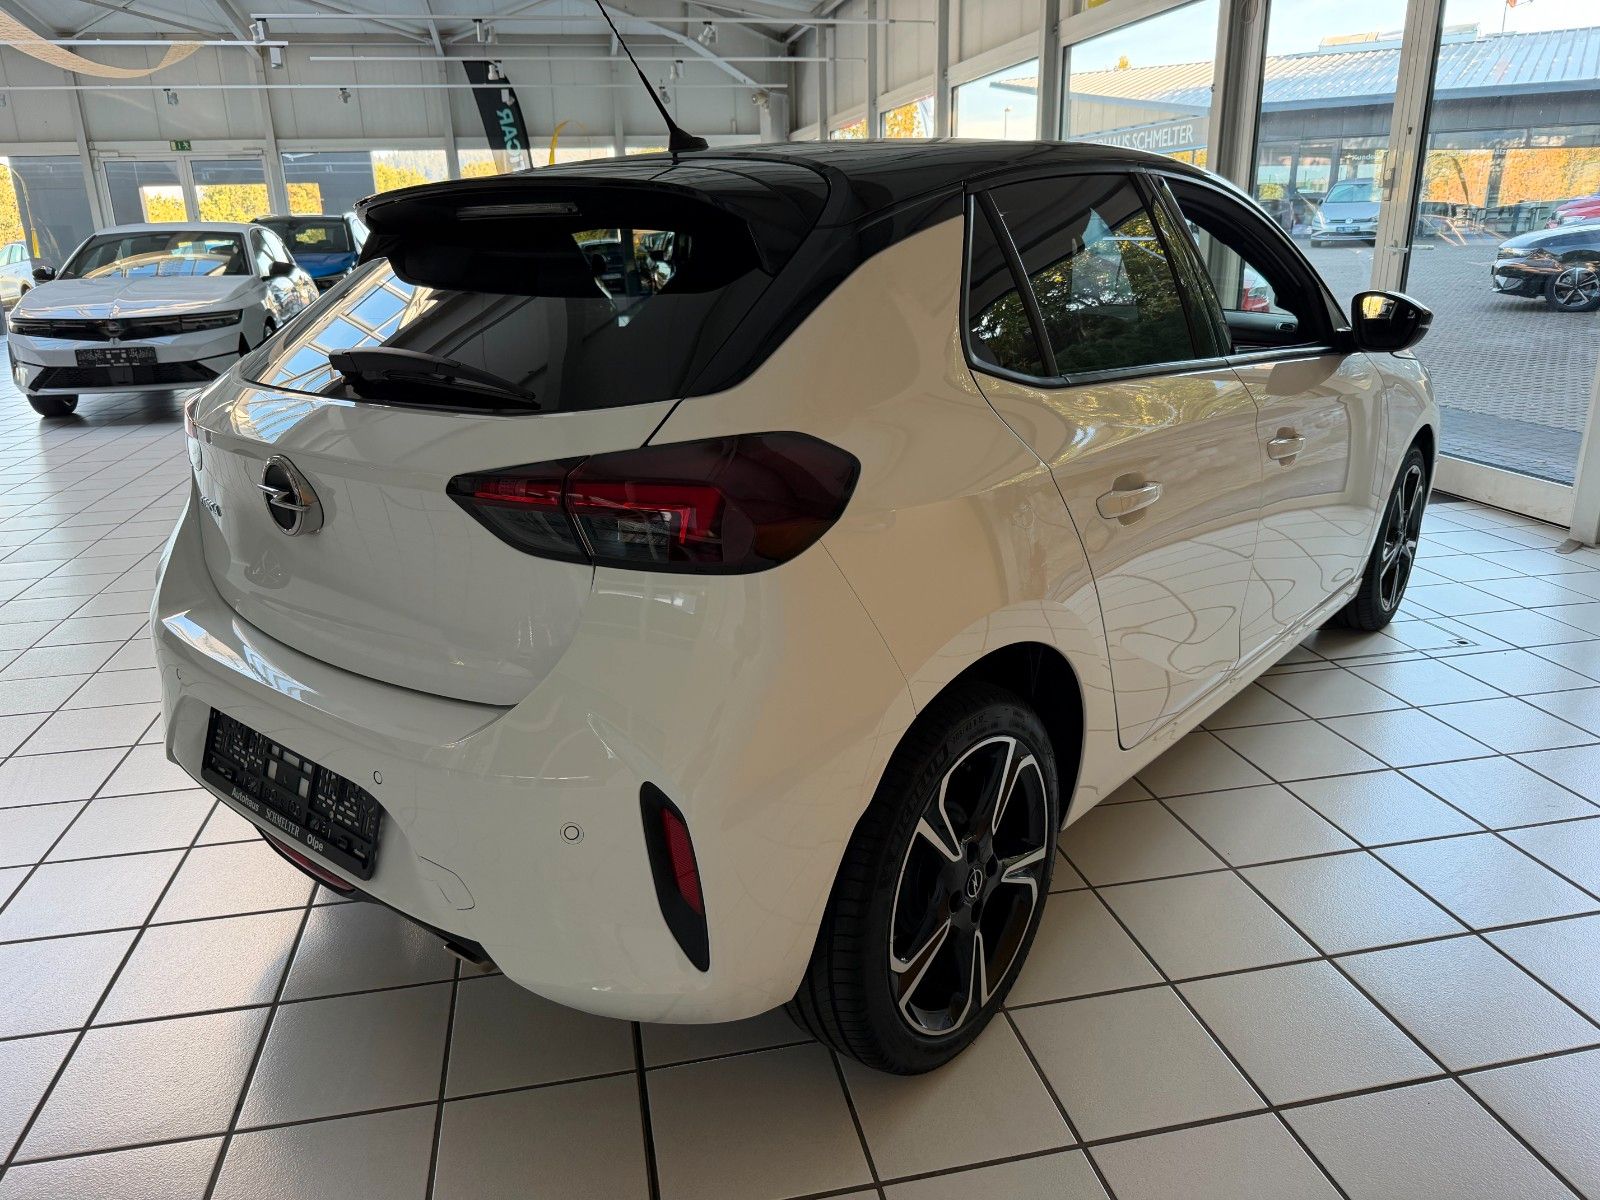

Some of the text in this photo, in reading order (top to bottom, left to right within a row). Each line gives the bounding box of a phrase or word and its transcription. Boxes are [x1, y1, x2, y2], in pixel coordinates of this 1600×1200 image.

[1132, 124, 1194, 150] SCHMELTER
[231, 787, 260, 812] Autohaus
[266, 808, 300, 838] SCHMELTER
[307, 833, 324, 851] Olpe
